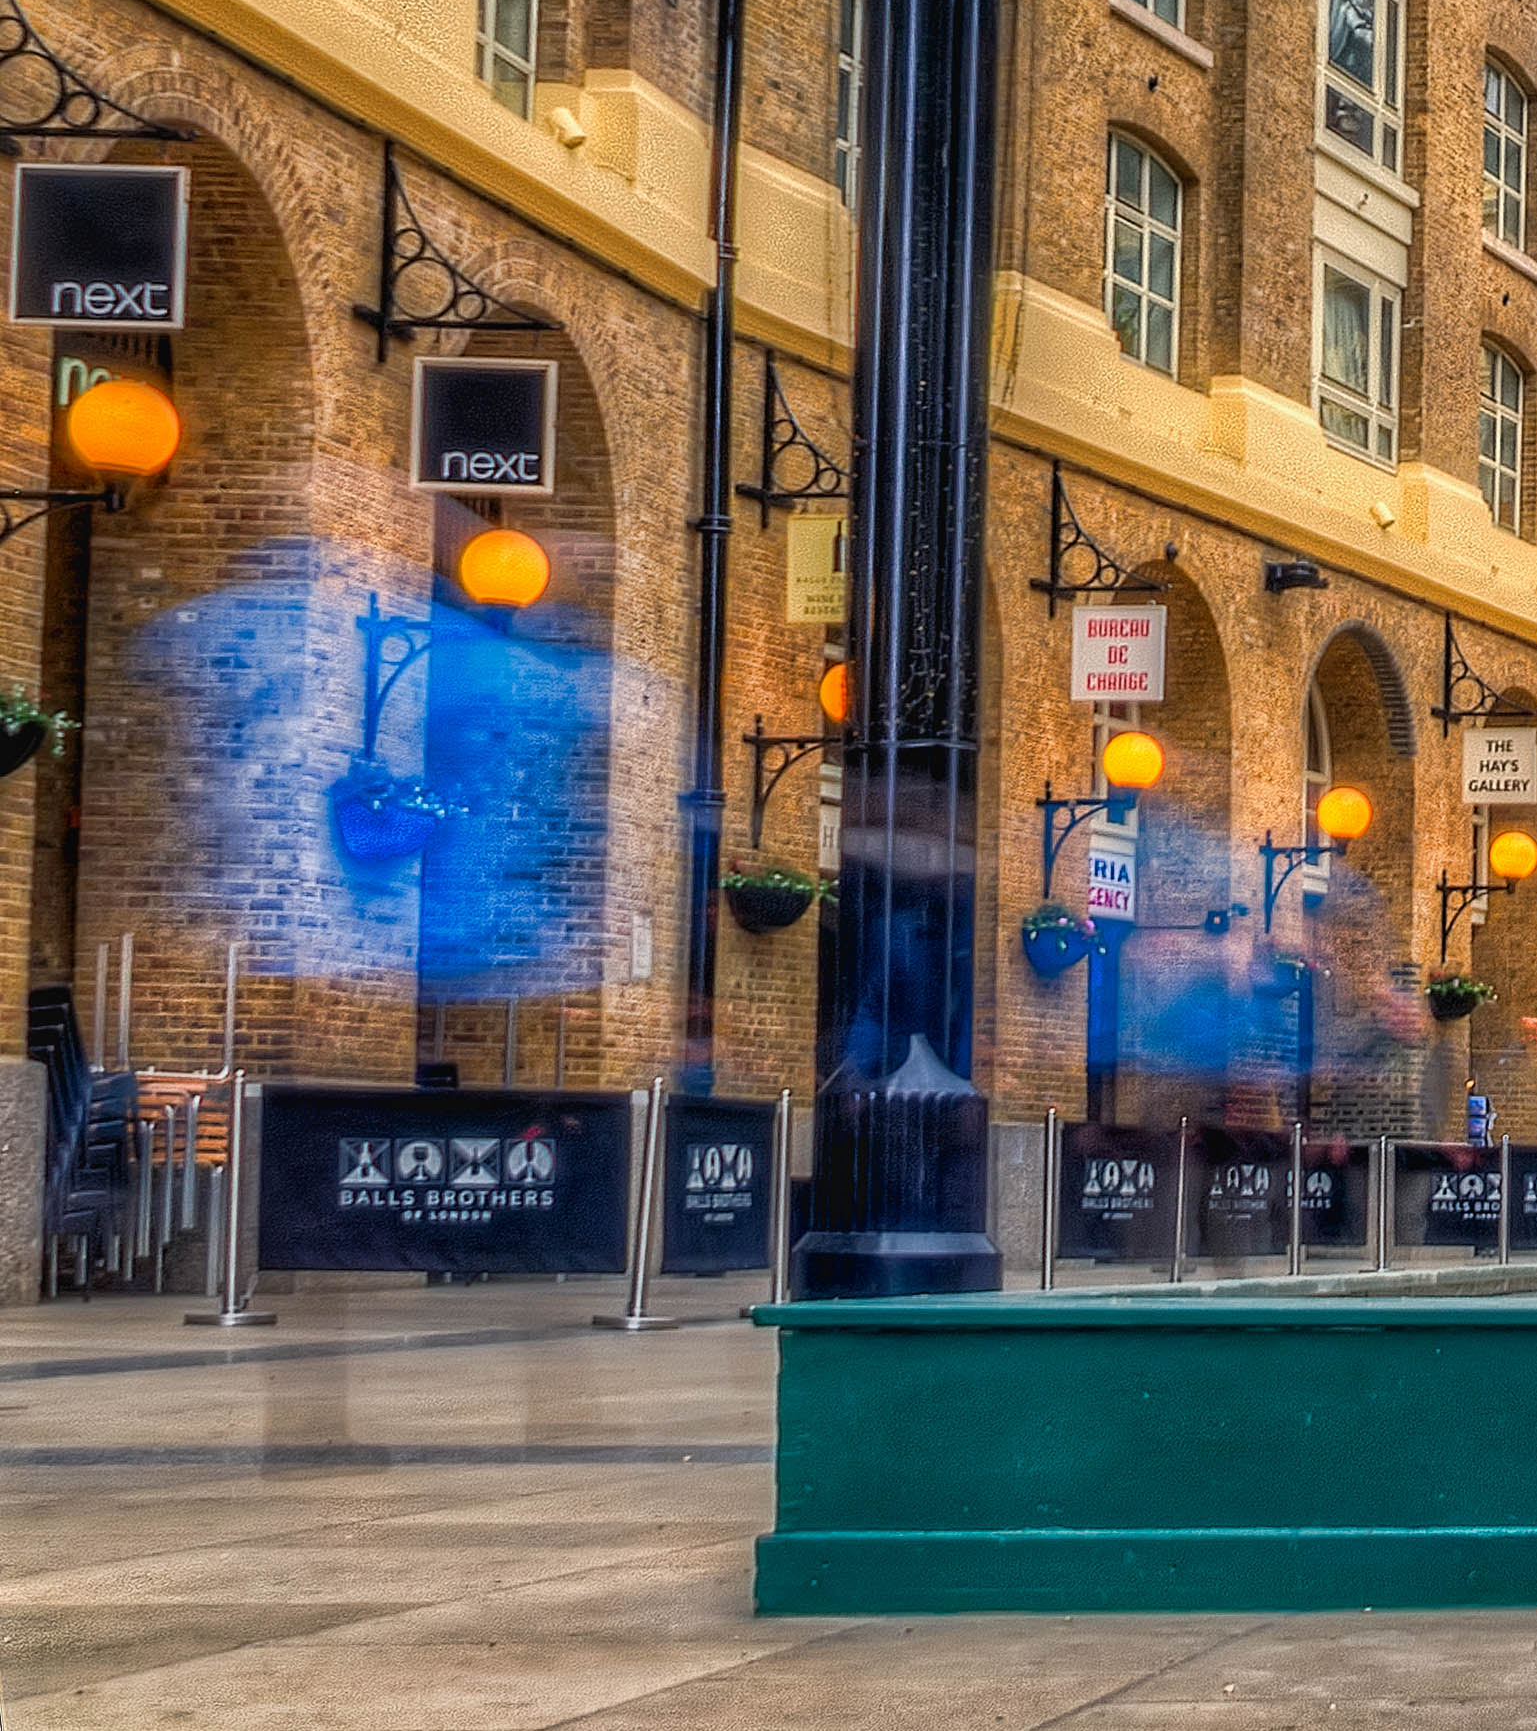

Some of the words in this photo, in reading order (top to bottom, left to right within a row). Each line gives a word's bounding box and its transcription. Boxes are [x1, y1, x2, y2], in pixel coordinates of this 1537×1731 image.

[52, 280, 169, 316] next
[441, 450, 540, 481] next
[1087, 619, 1150, 638] BUREAU
[1107, 645, 1128, 664] DE
[1086, 672, 1148, 691] CHANGE
[1486, 739, 1514, 753] THE
[1480, 759, 1520, 773] HAY'S
[1468, 779, 1531, 792] GALLERY
[1089, 857, 1131, 884] RIA
[339, 1189, 416, 1206] BALLS
[425, 1189, 555, 1206] BROTHERS
